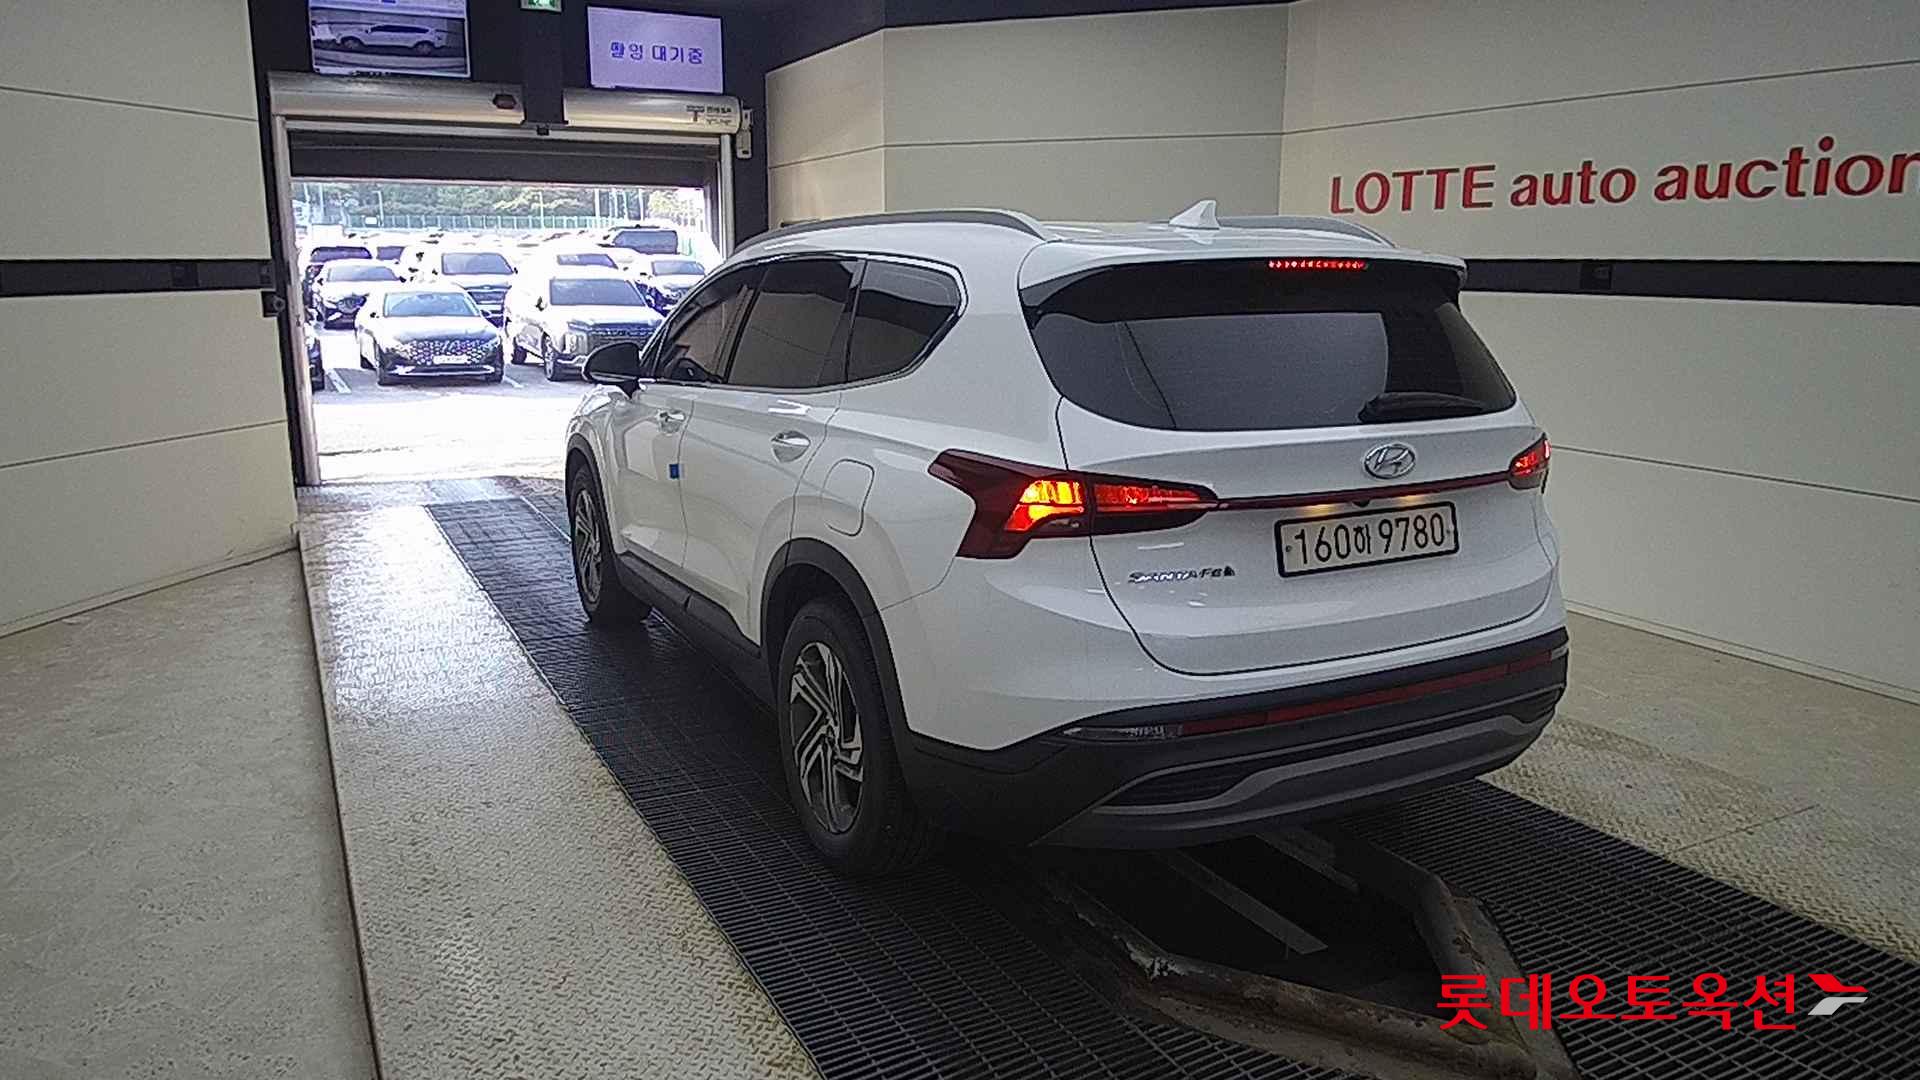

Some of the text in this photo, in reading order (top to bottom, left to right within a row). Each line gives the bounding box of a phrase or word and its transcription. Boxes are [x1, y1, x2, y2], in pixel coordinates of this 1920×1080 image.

[651, 45, 703, 65] 대기중
[1330, 136, 1920, 213] LOTTE auto auction
[1378, 513, 1446, 554] 9780
